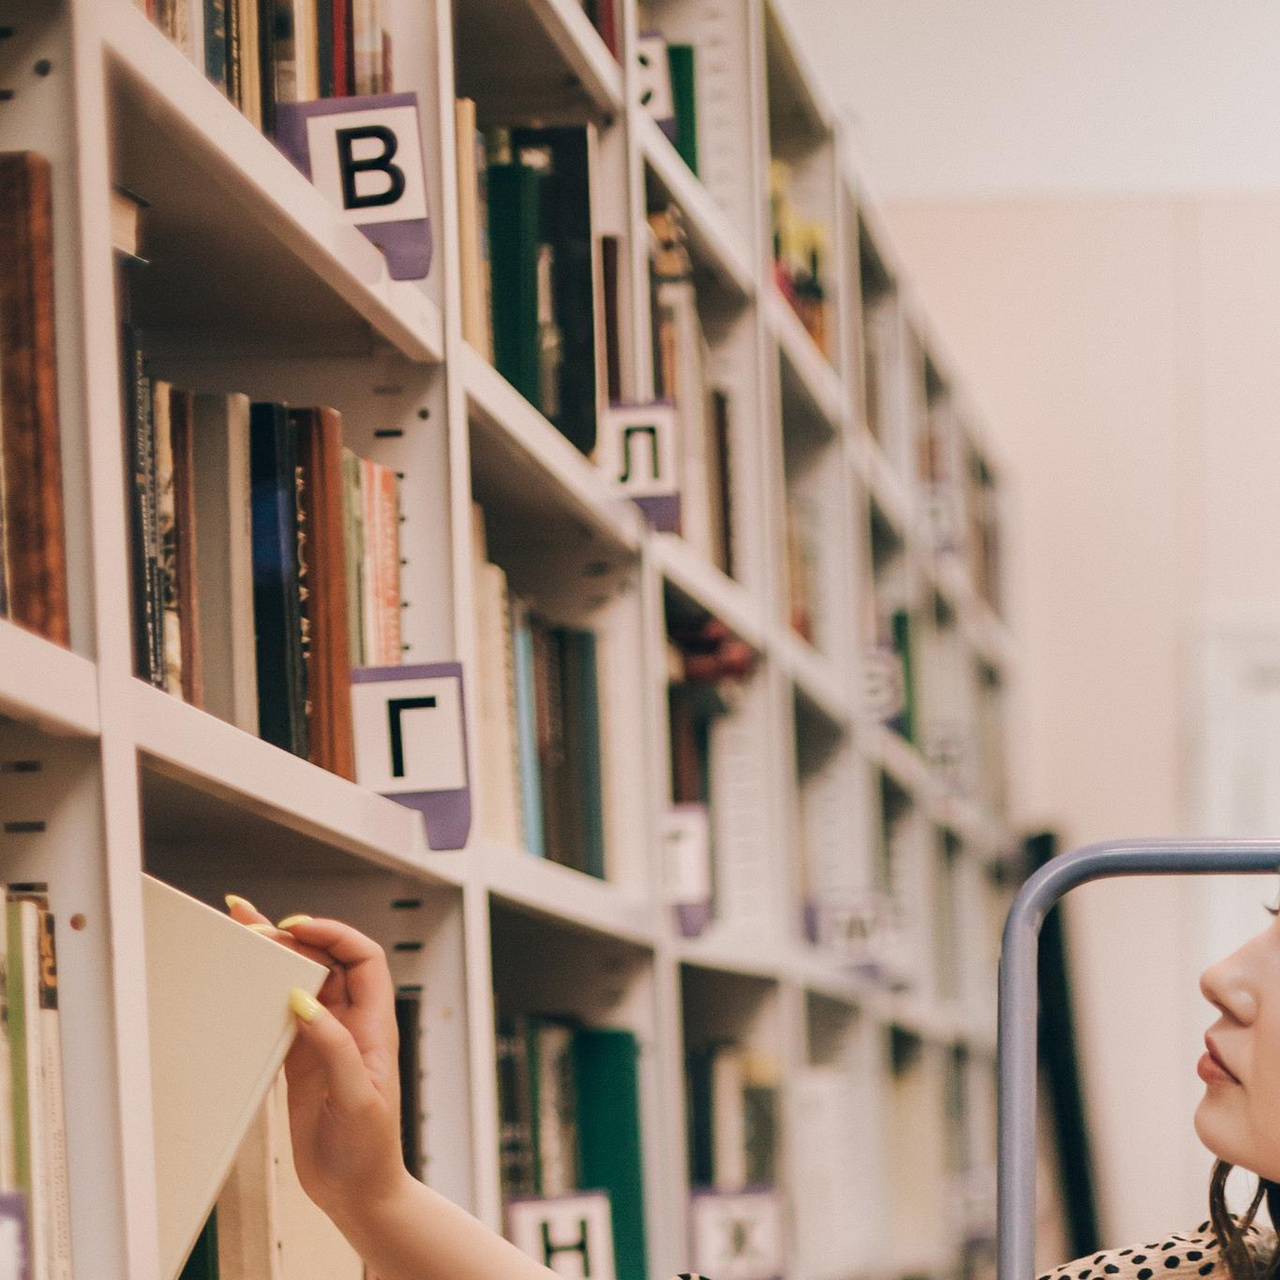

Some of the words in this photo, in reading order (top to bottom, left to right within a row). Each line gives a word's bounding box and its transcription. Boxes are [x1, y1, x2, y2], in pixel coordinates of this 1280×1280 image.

[335, 125, 405, 209] В
[620, 426, 658, 482] Л
[388, 697, 436, 777] Г
[541, 1220, 590, 1278] Н
